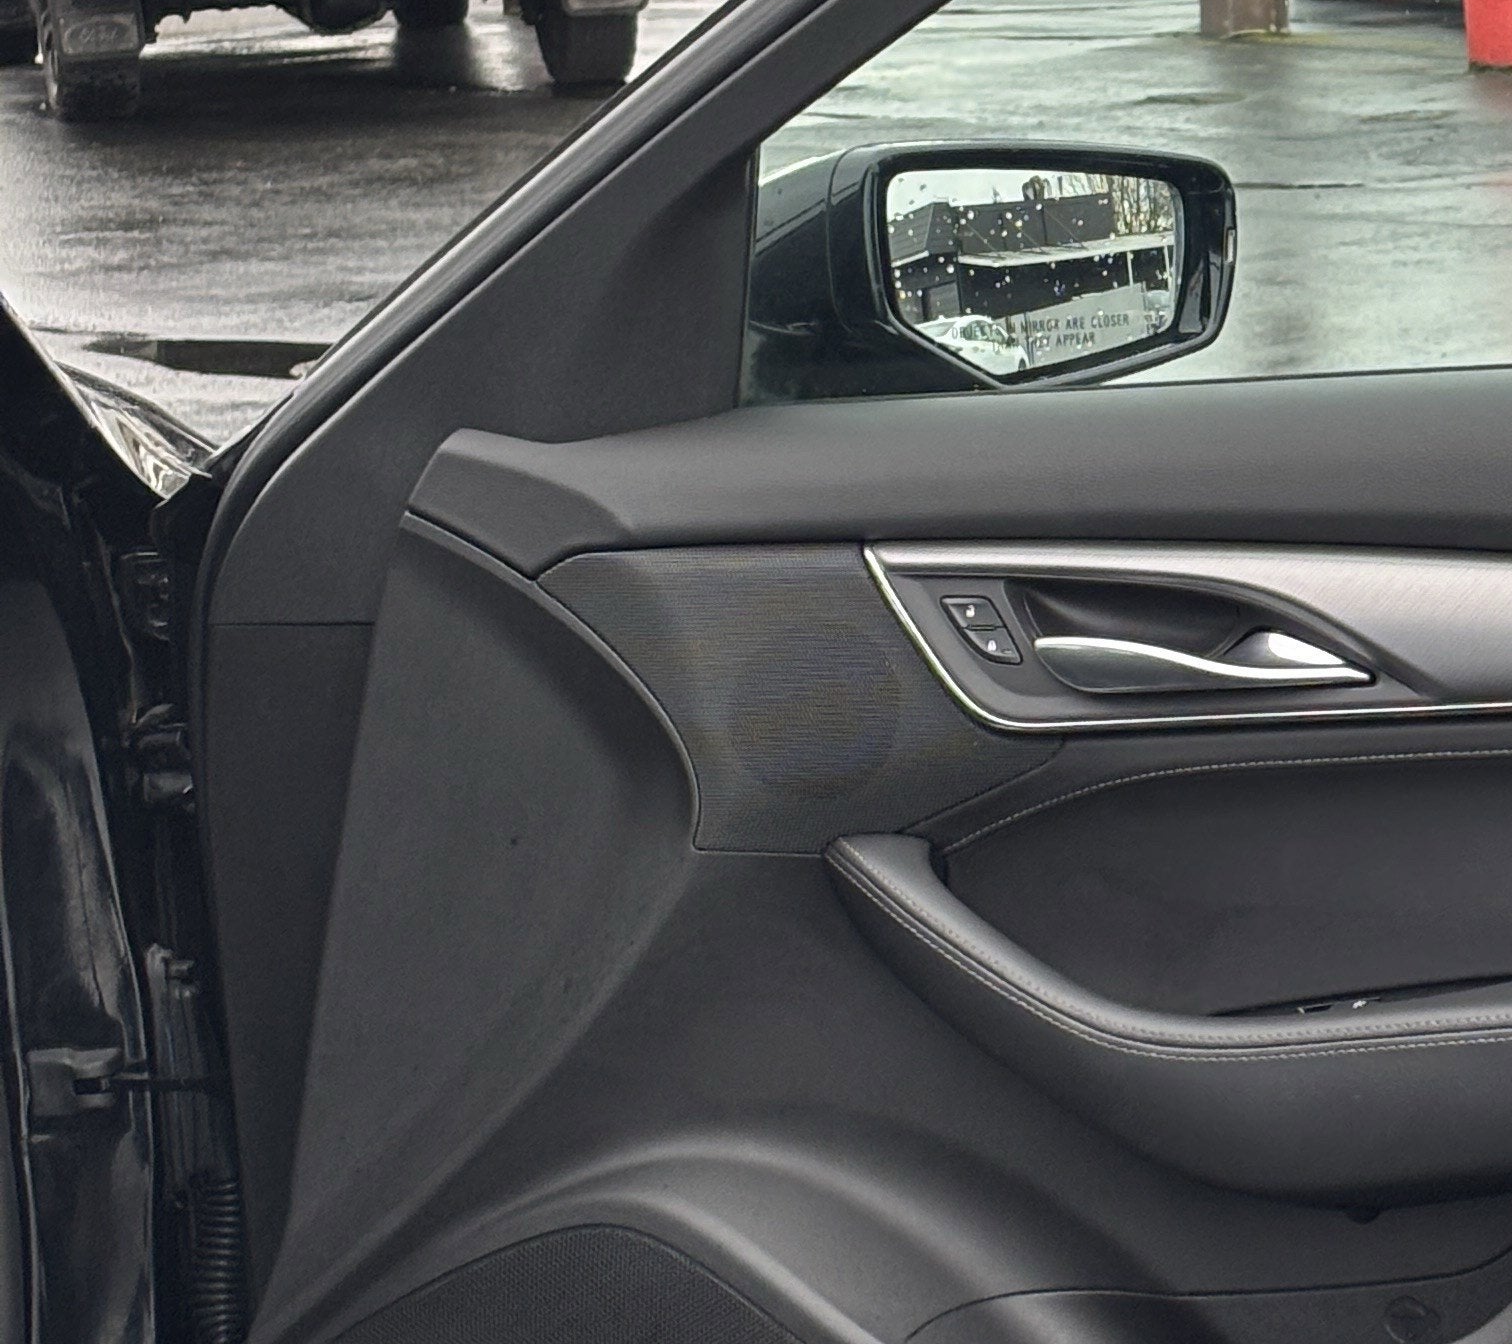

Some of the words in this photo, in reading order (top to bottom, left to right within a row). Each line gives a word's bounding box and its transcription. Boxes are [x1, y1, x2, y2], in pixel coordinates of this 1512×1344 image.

[1066, 316, 1085, 330] ARE
[1091, 313, 1130, 328] CLOSER
[1056, 330, 1096, 347] APPEAR
